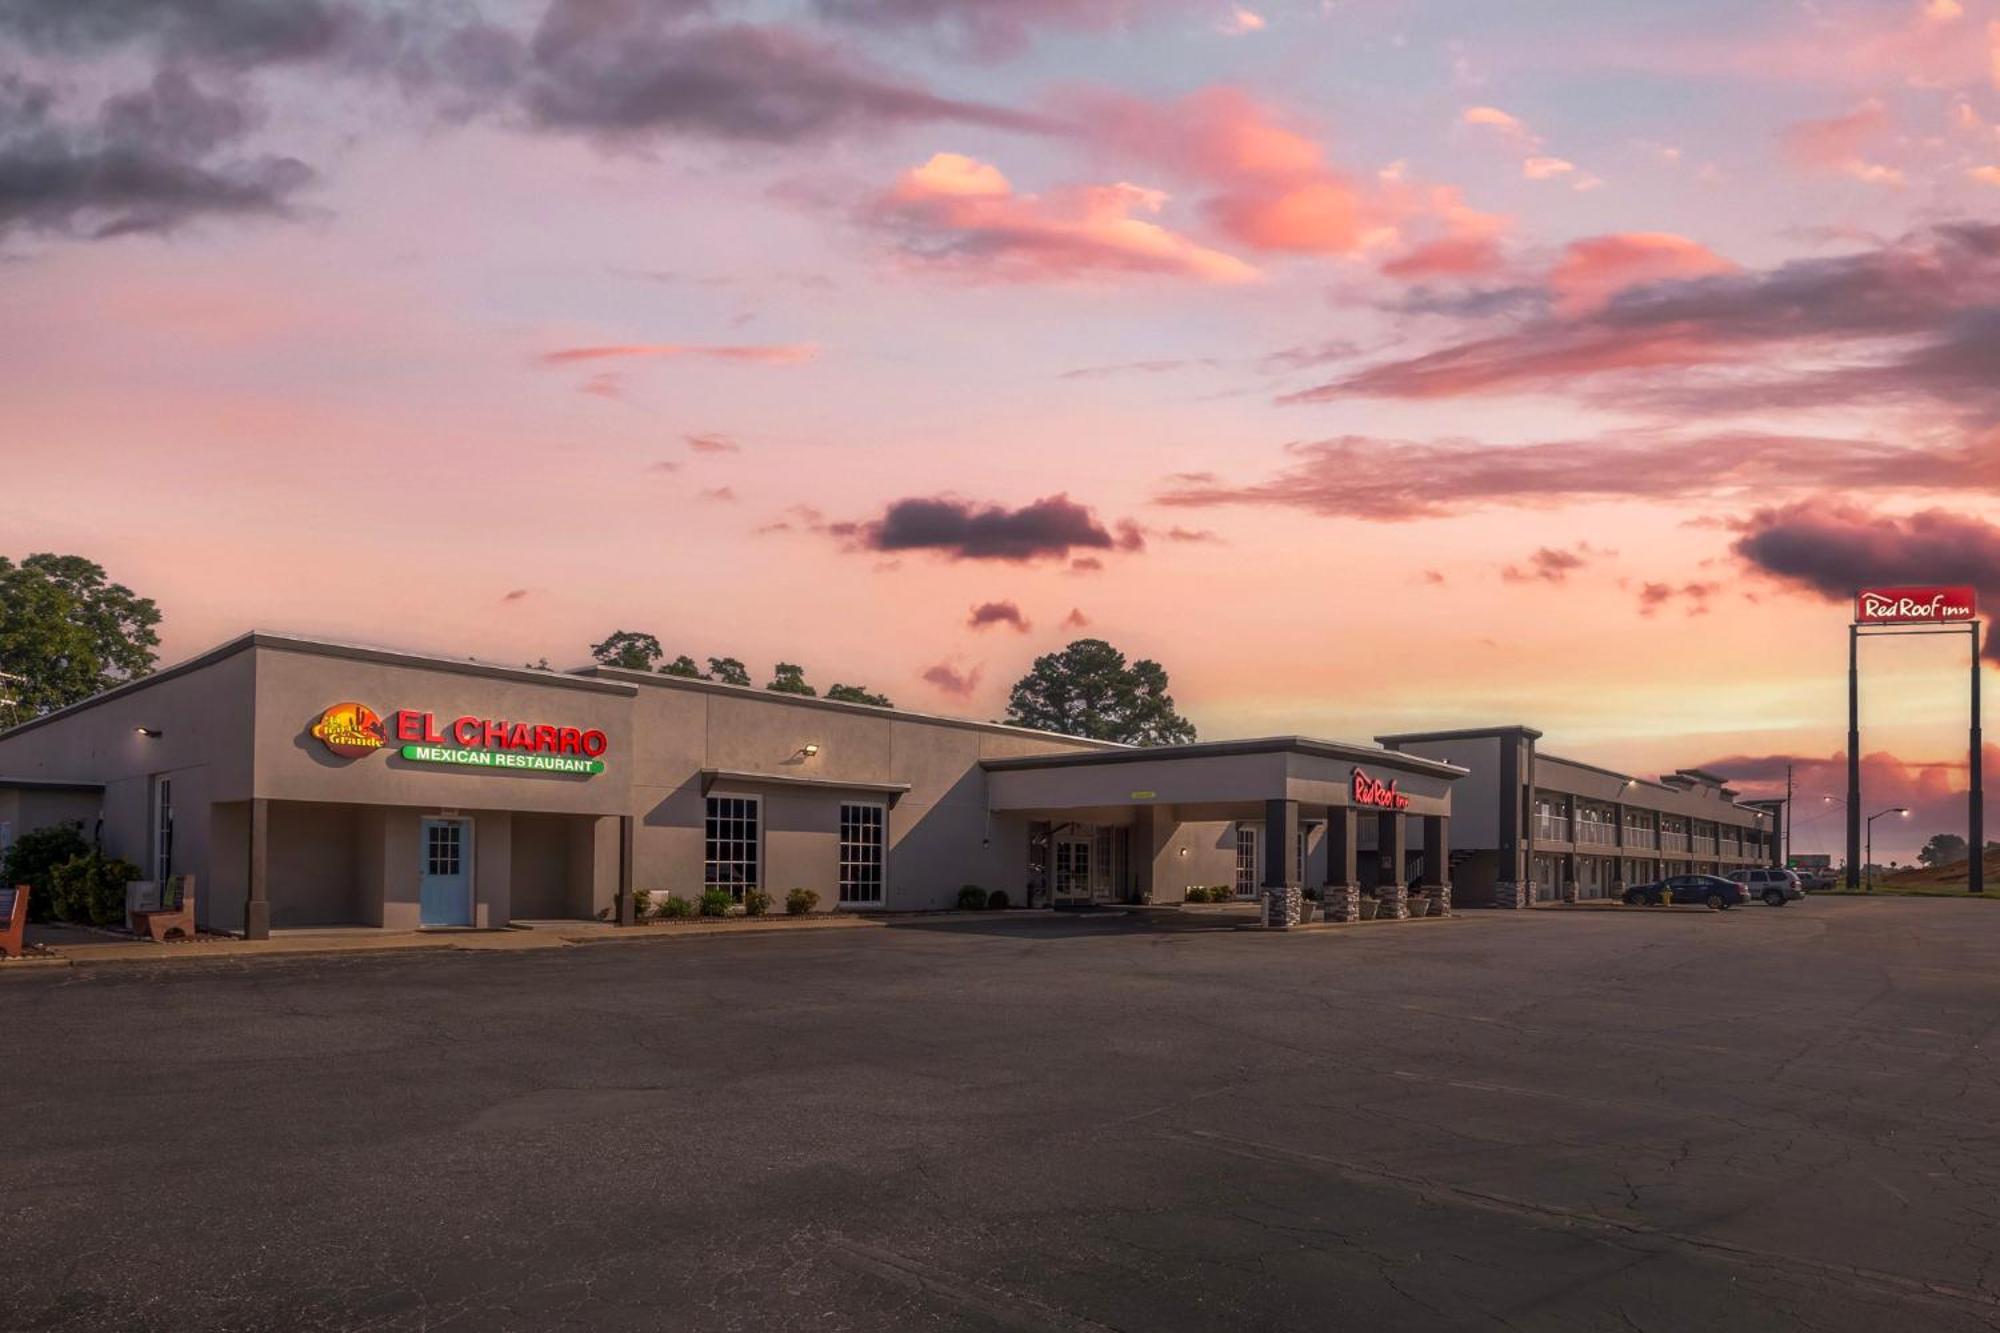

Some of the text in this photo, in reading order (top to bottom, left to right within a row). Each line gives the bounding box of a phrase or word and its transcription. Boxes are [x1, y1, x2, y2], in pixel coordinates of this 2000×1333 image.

[397, 710, 608, 758] EL CHARRO
[416, 746, 592, 772] MEXICAN RESTAURANT
